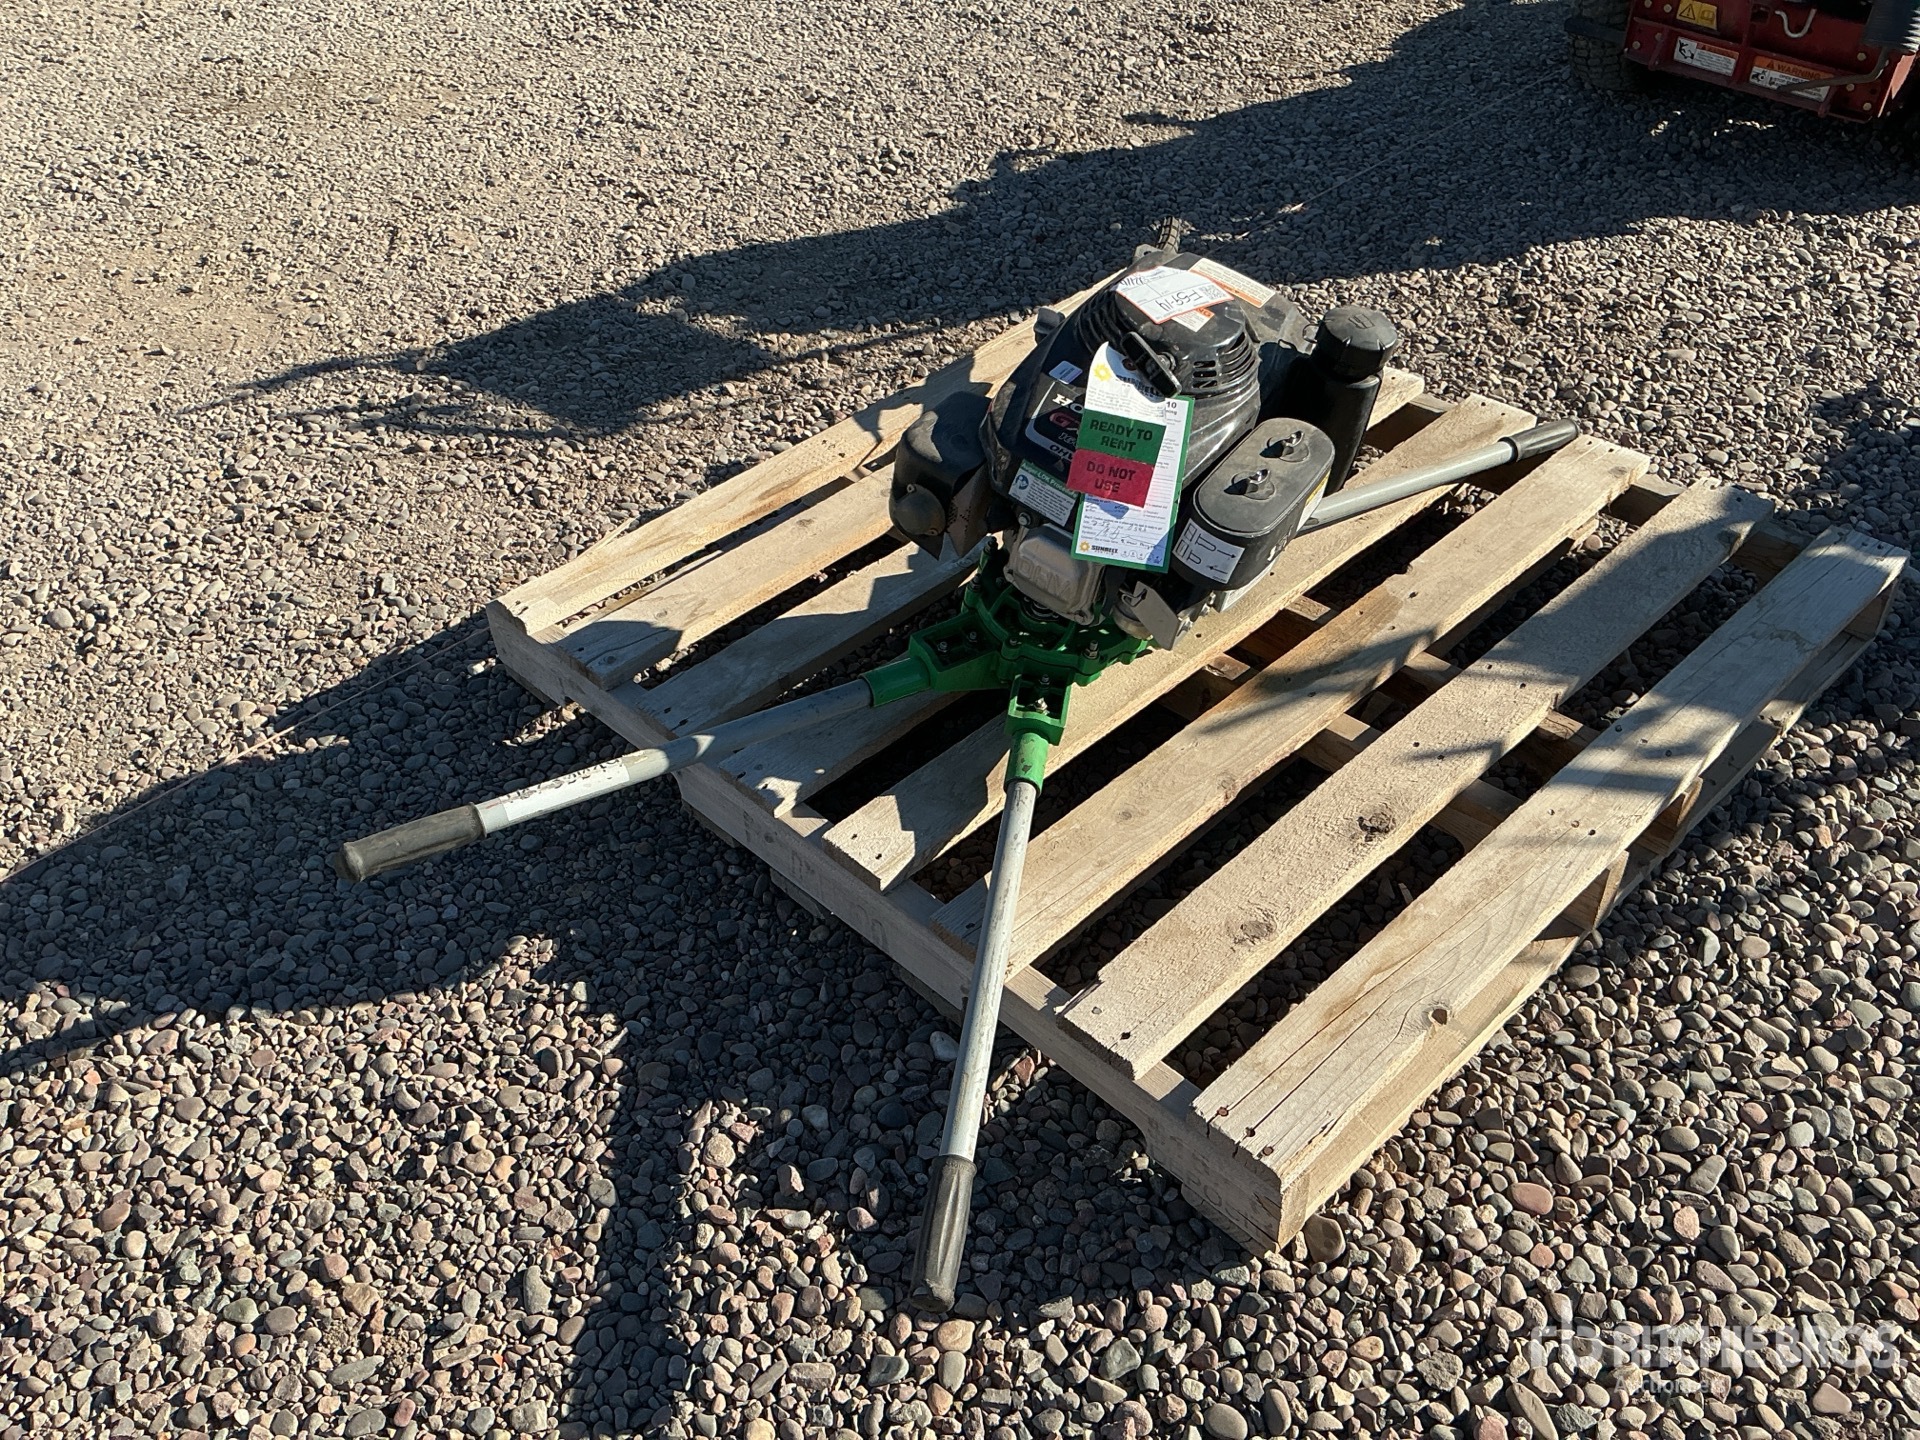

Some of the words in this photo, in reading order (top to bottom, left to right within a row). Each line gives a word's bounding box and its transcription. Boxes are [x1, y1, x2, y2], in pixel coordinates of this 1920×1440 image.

[1777, 61, 1821, 80] WARNING
[1089, 419, 1134, 438] READY
[1137, 428, 1153, 441] TO
[1100, 435, 1136, 452] RENT
[1086, 461, 1106, 475] DO
[1108, 466, 1136, 481] NOT
[1094, 478, 1121, 493] USE
